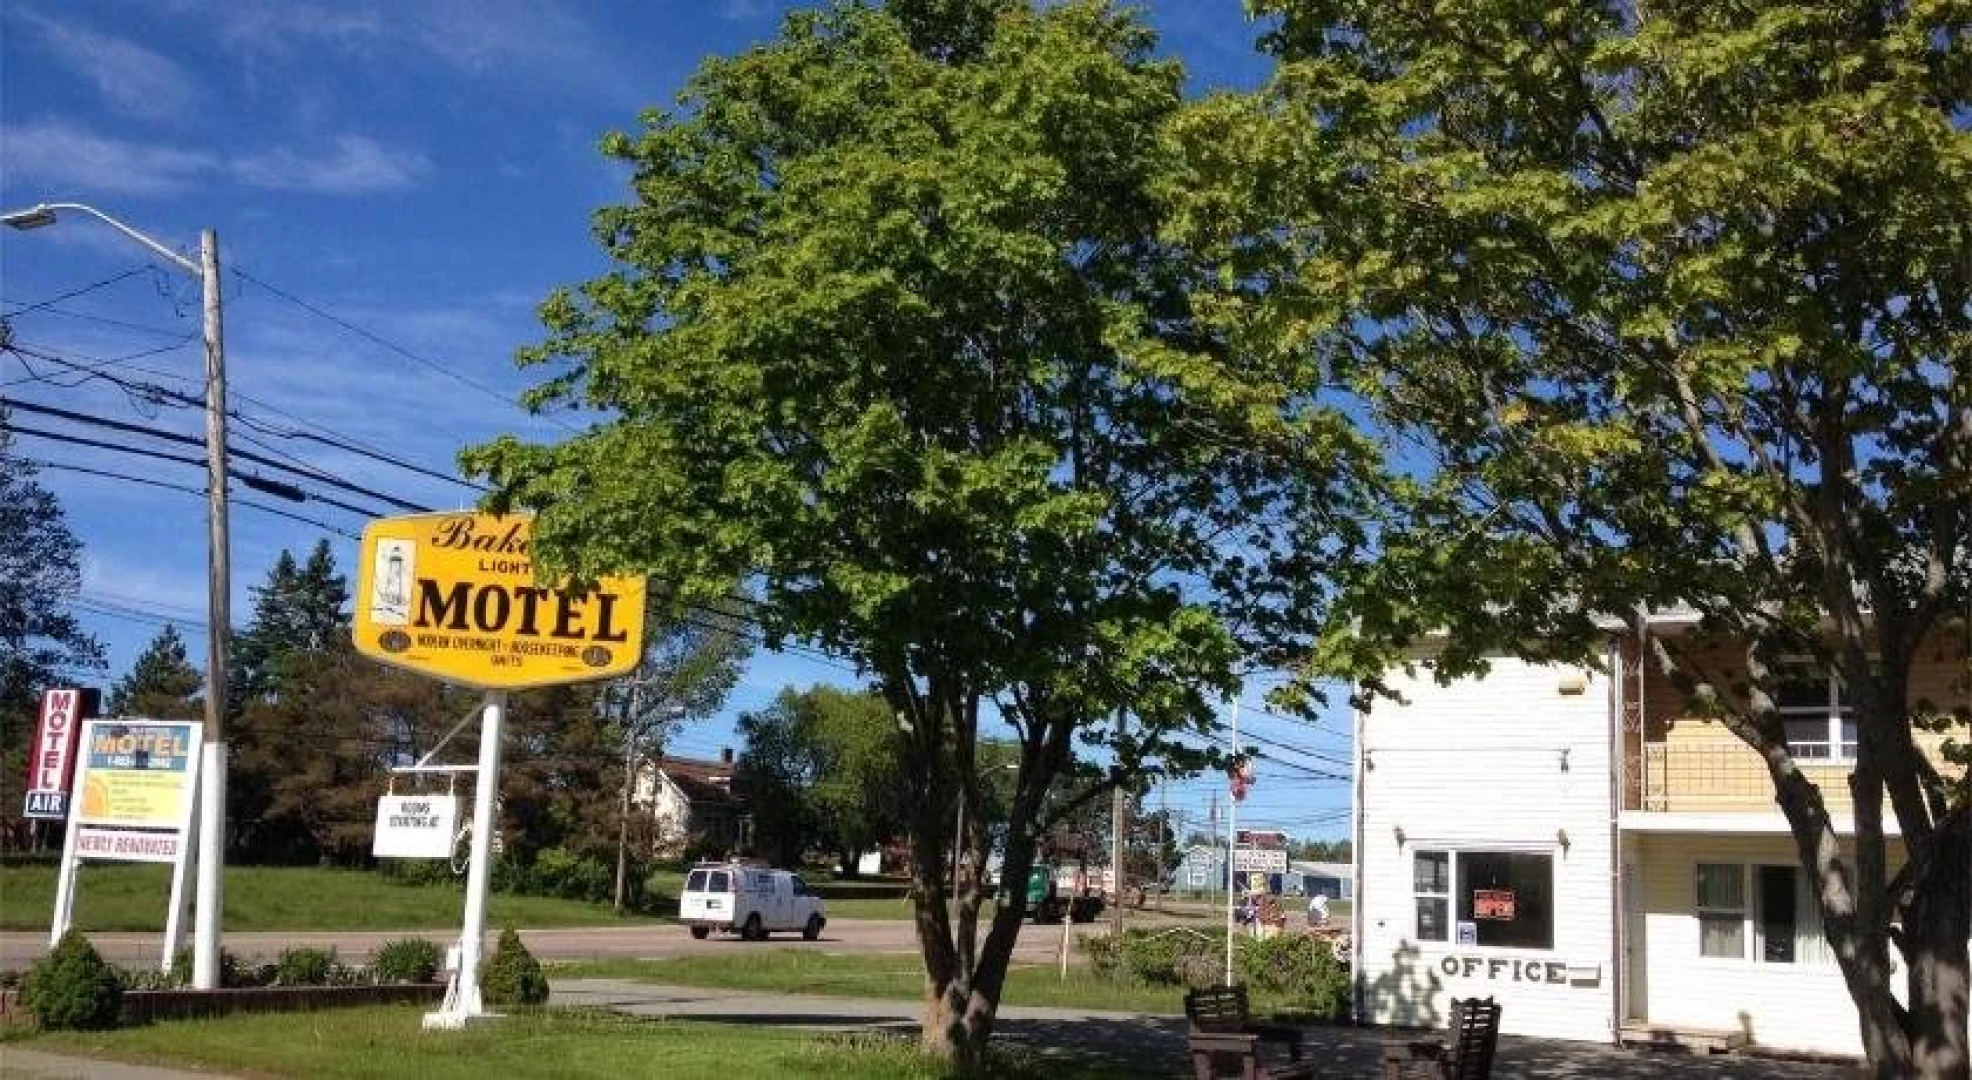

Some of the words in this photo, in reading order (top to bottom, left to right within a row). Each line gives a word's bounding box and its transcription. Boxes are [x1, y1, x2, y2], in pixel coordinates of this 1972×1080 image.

[413, 579, 627, 641] MOTEL
[41, 692, 71, 788] MOTEL
[94, 732, 189, 757] MOTEL
[30, 795, 62, 812] AIR
[1441, 955, 1568, 984] OFFICE
